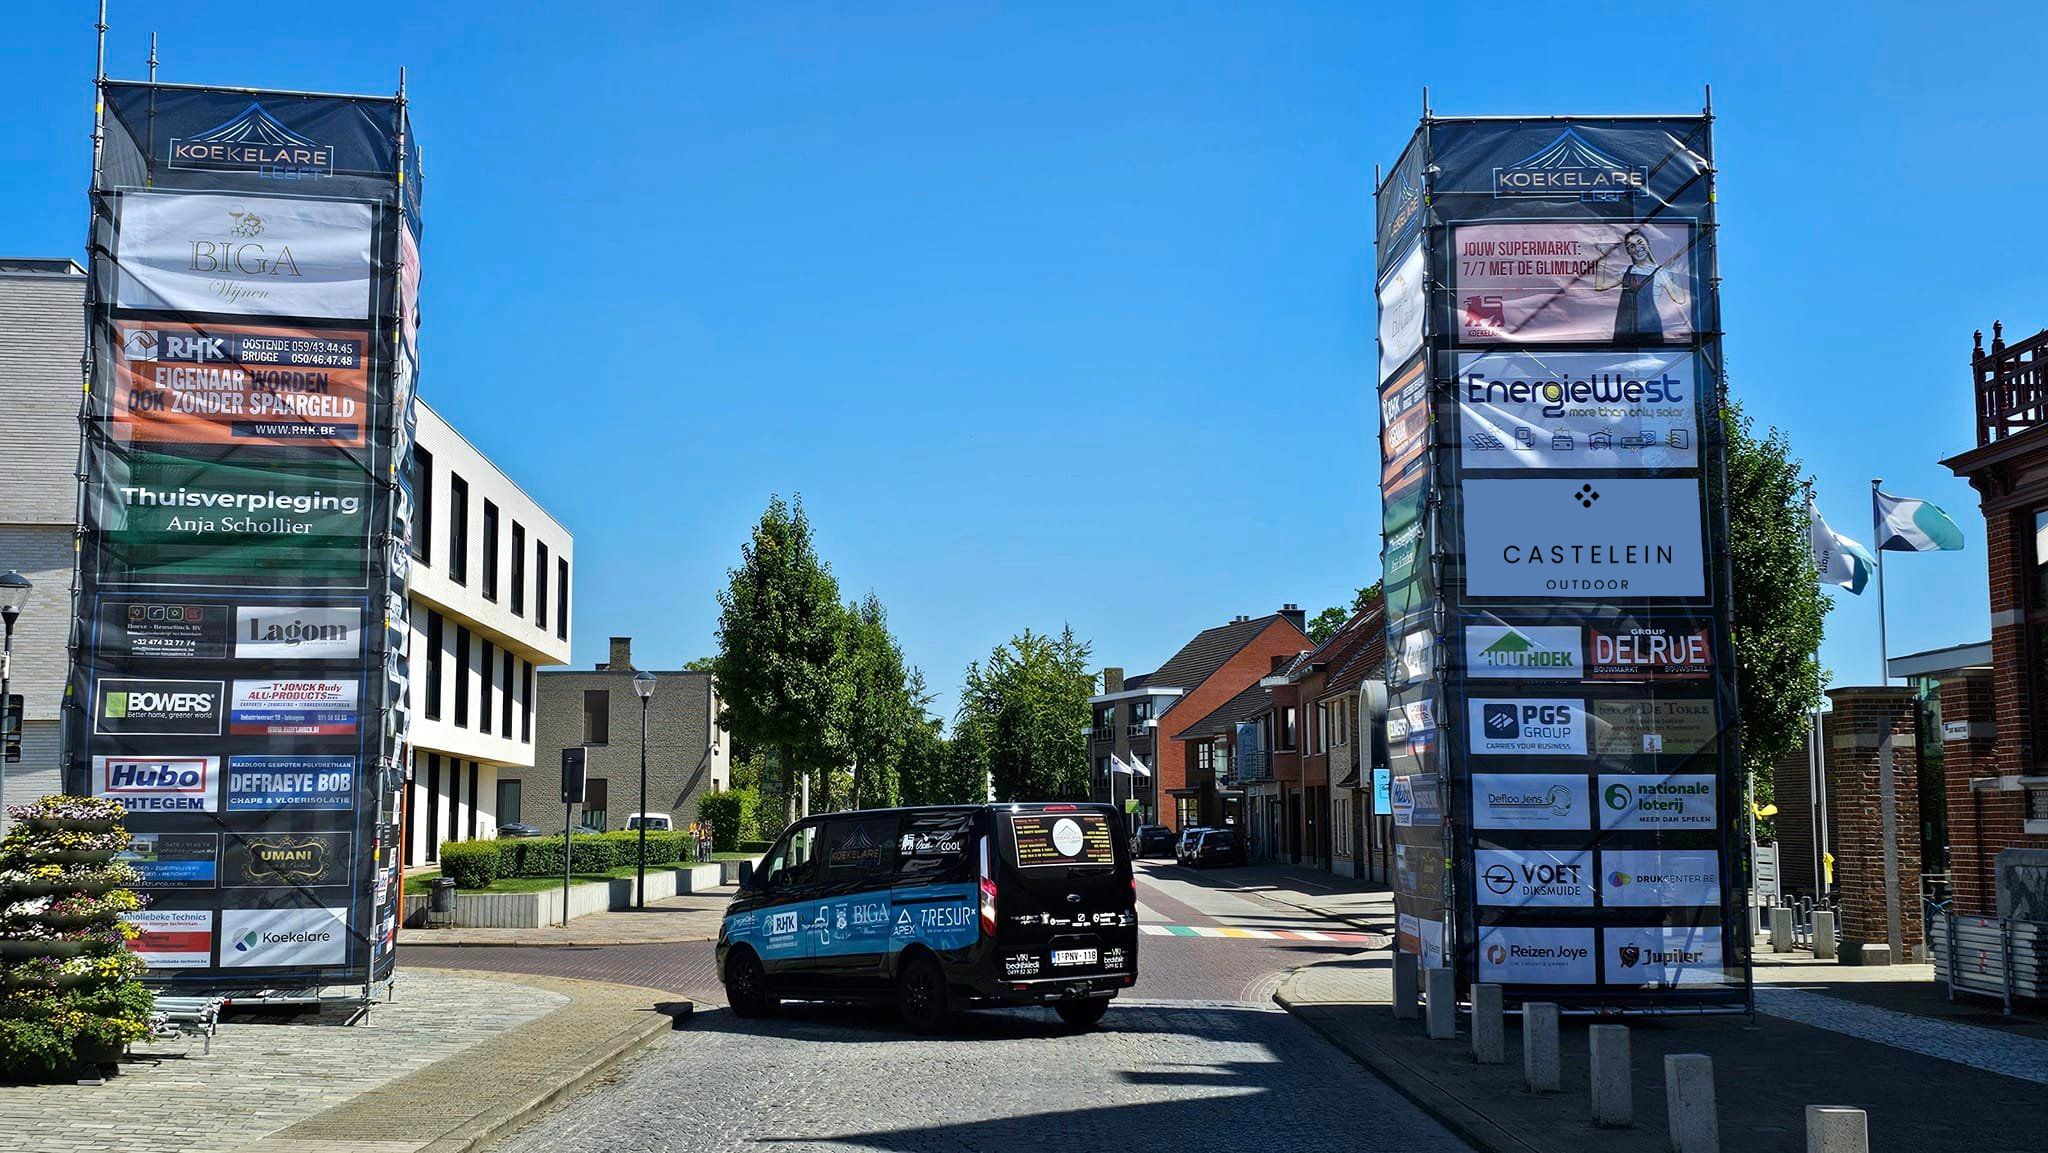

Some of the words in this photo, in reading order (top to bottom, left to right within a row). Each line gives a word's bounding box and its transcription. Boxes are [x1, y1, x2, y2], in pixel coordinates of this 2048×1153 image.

[175, 144, 328, 165] KOEKELARE
[1499, 171, 1643, 187] KOEKELARE
[1463, 241, 1495, 256] JOUW
[1498, 241, 1581, 256] SUPERMARKT:
[188, 239, 304, 277] BIGA
[1463, 262, 1486, 276] 7/7
[1489, 261, 1515, 276] MET
[1518, 261, 1533, 275] DE
[208, 279, 271, 305] Wijnen
[166, 336, 226, 363] RHK
[242, 338, 290, 351] OOSTENDE
[292, 340, 353, 354] 059/43.44.45
[241, 351, 279, 363] BRUGGE
[291, 353, 353, 366] 050/46.47.48
[155, 367, 245, 391] EIGENAAR
[250, 370, 328, 394] WORDEN
[128, 388, 165, 411] OOK
[171, 390, 244, 415] ZONDER
[249, 393, 355, 418] SPAARGELD
[1467, 374, 1684, 418] EnergieWest
[1569, 408, 1596, 417] more
[1598, 406, 1627, 417] than
[1629, 406, 1654, 419] only
[1656, 407, 1684, 417] solar
[255, 424, 336, 436] WWW.RHK.BE
[120, 487, 360, 514] Thuisverpleging
[166, 516, 214, 535] Anja
[221, 516, 313, 535] Schollier
[1503, 545, 1672, 564] CASTELEIN
[1546, 579, 1629, 590] OUTDOOR
[250, 618, 347, 647] Lagom
[1630, 628, 1666, 636] GROUP
[1596, 635, 1705, 665] DELRUE
[1487, 651, 1573, 667] HOUTHOEK
[318, 684, 342, 693] Rudy
[128, 692, 212, 712] BOWERS
[1522, 705, 1571, 725] PGS
[1524, 726, 1571, 738] GROUP
[111, 764, 200, 787] Hubo
[230, 773, 313, 793] DEFRAEYE
[317, 773, 351, 792] BOB
[1638, 782, 1710, 794] nationale
[108, 797, 205, 810] CHTEGEM
[1488, 793, 1518, 804] Defloo
[1519, 794, 1543, 804] Jens
[1638, 798, 1684, 813] loterij
[941, 841, 961, 851] COOL
[260, 850, 312, 861] UMANI
[1521, 864, 1582, 884] VOET
[1522, 885, 1581, 896] DIKSMUIDE
[119, 913, 170, 921] anhollebeke
[172, 913, 207, 921] Technics
[853, 903, 890, 924] BIGA
[775, 915, 796, 932] RHK
[892, 925, 916, 936] APEX
[262, 931, 330, 944] Koekelare
[1510, 944, 1554, 958] Reizen
[1556, 945, 1588, 961] Joye
[1643, 949, 1703, 965] Jupiler
